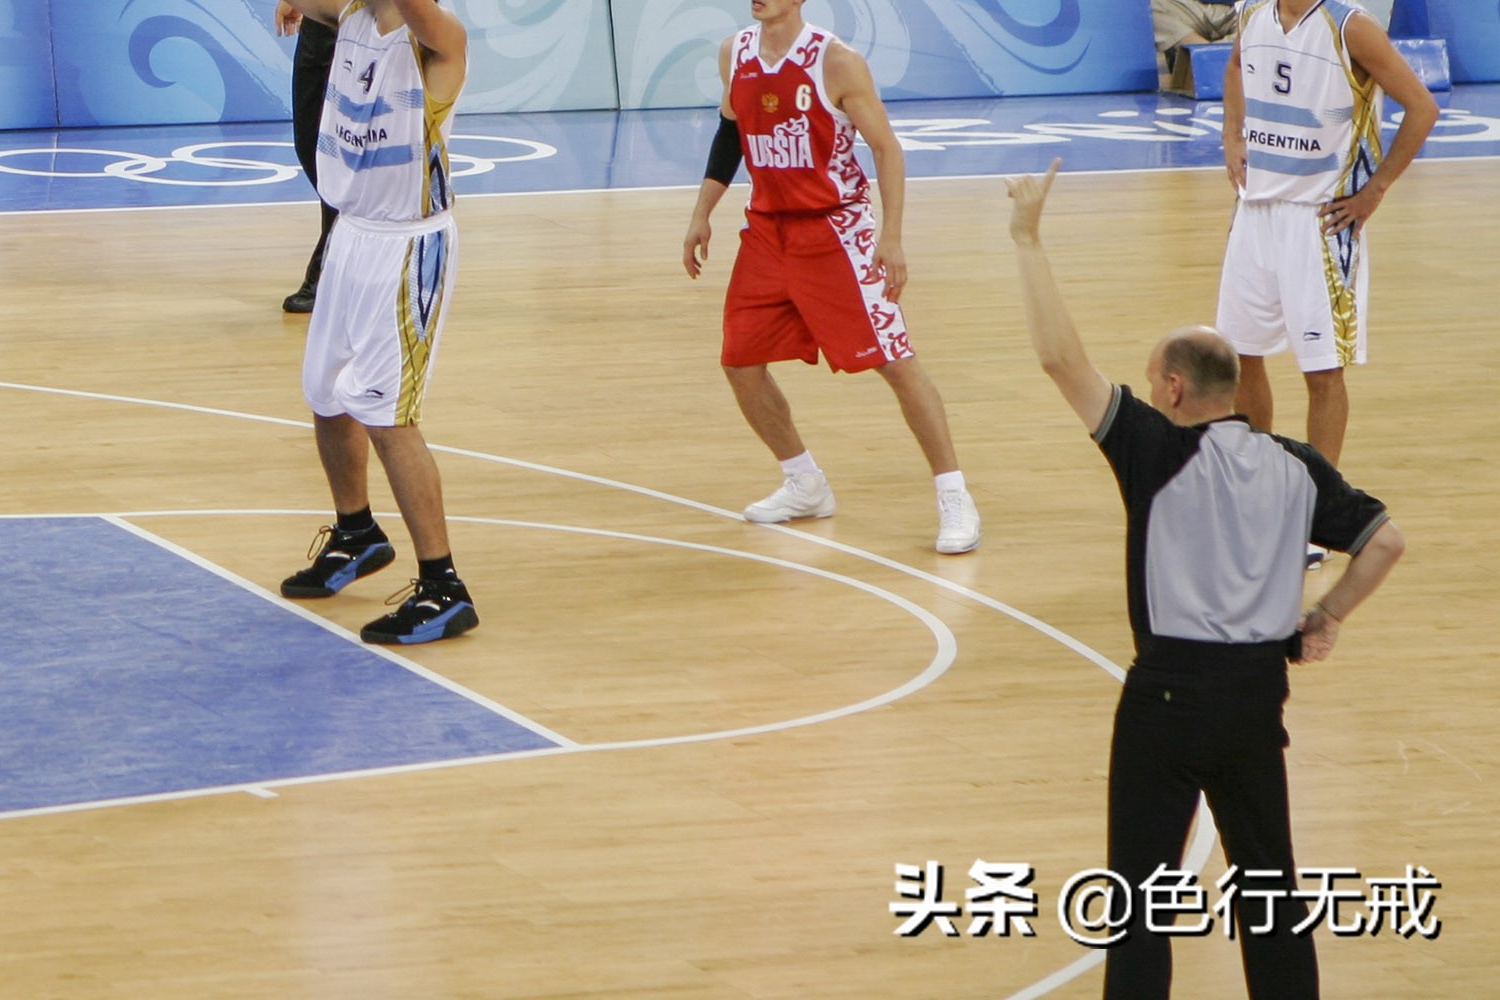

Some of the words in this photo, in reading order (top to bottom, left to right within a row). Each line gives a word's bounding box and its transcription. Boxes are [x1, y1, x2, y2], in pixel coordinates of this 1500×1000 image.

[357, 59, 378, 95] 4
[1272, 60, 1292, 96] 5
[795, 84, 812, 112] 6
[1246, 128, 1322, 152] RGENTINA
